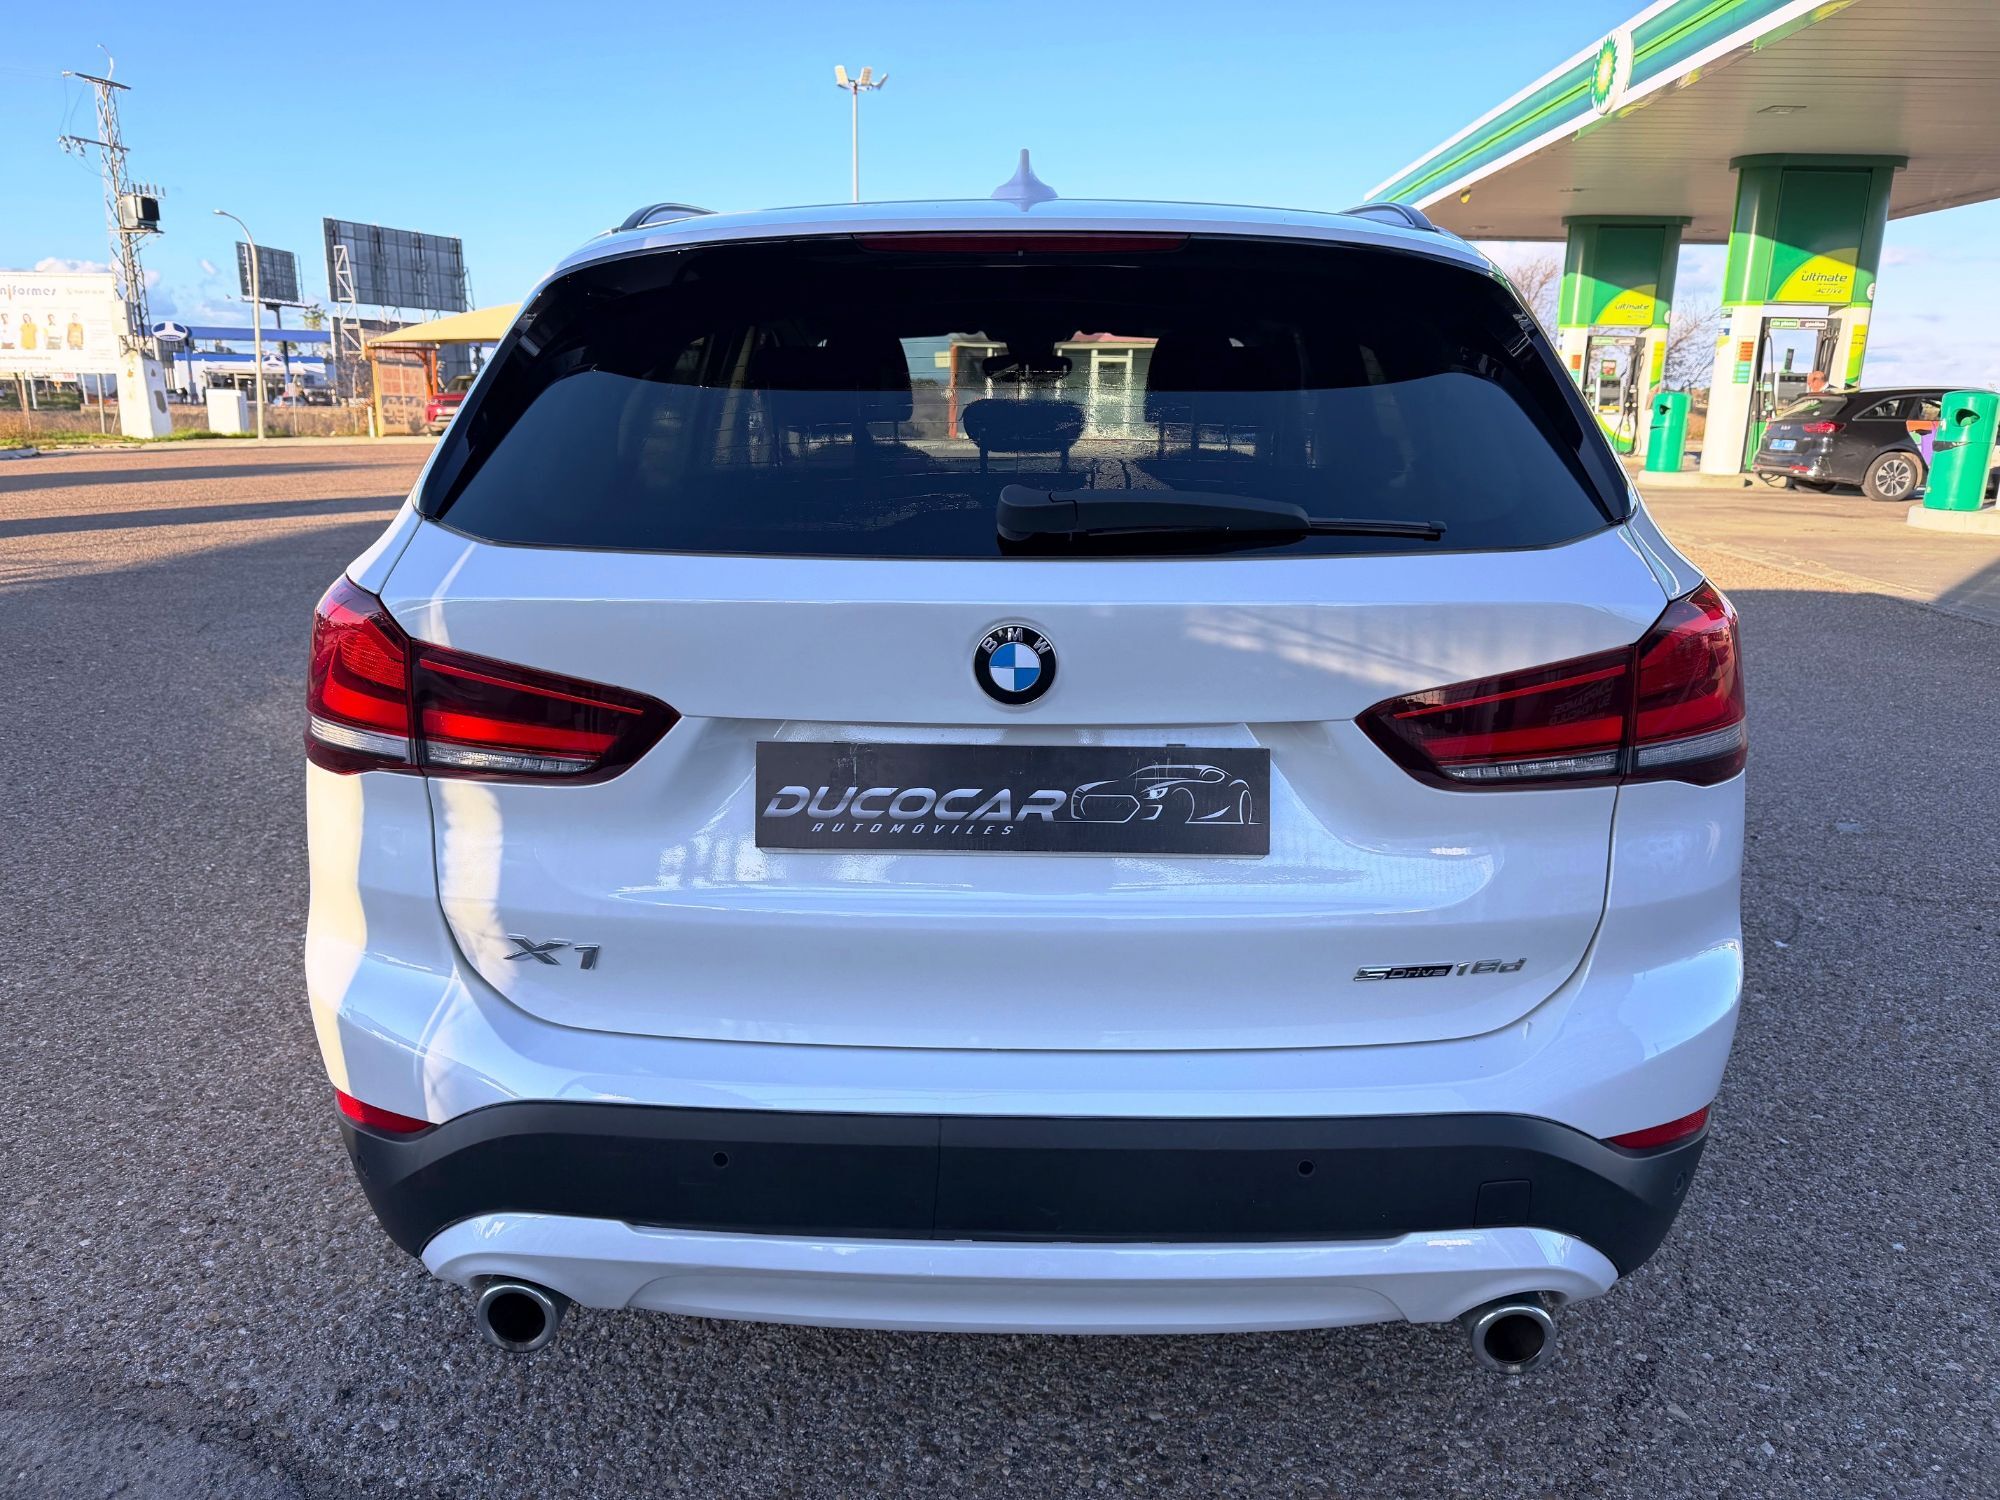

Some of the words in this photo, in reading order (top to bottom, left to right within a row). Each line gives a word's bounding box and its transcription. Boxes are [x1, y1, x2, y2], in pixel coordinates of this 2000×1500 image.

[1801, 273, 1848, 282] ultimate
[981, 627, 1051, 655] BMW
[762, 786, 1067, 822] DUCOCAR
[811, 823, 1014, 835] AUTOMÓVILES
[503, 933, 600, 970] X1
